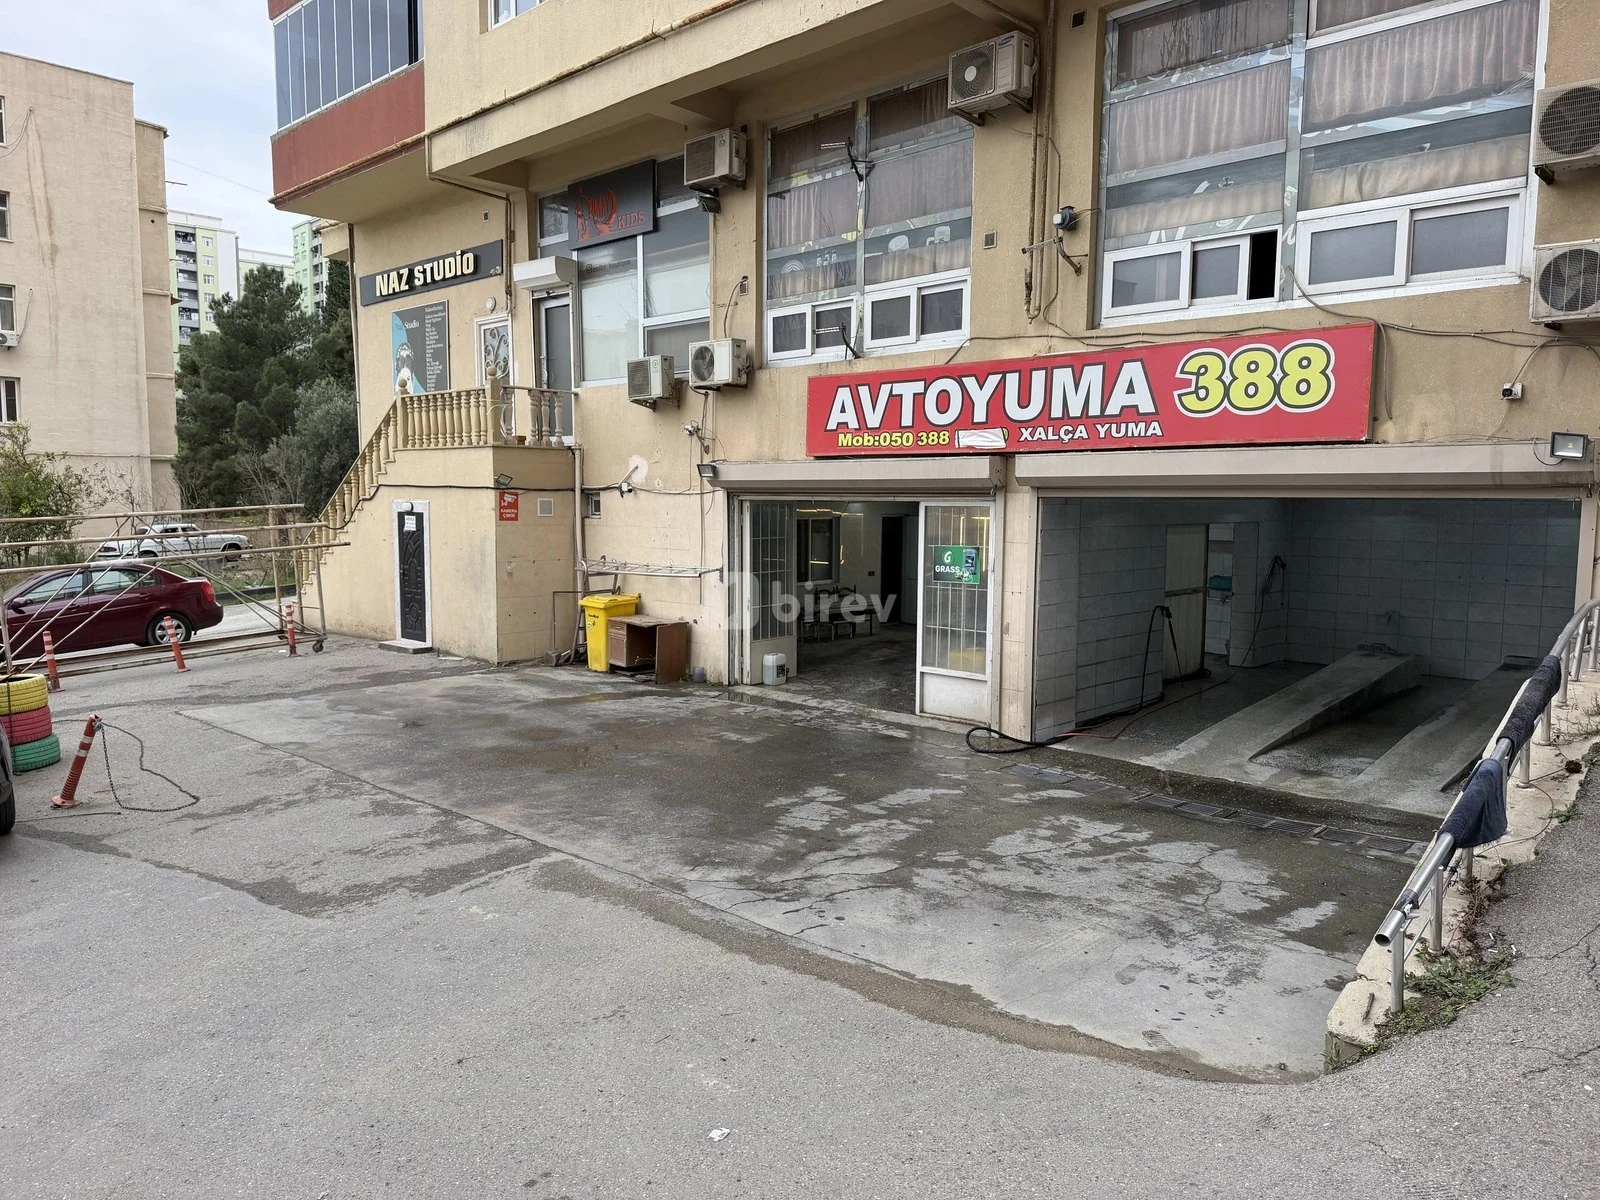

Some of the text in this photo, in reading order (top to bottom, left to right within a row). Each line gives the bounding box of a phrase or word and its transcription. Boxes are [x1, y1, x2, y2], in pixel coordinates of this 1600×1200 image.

[617, 211, 646, 229] KIDS
[375, 268, 409, 297] NAZ
[1176, 340, 1333, 415] 388
[825, 358, 1158, 431] AVTOYUMA
[837, 431, 914, 447] Mob:050
[917, 430, 950, 446] 388
[1019, 426, 1089, 443] XALÇA
[1095, 421, 1163, 438] YUMA
[935, 565, 960, 573] GRASS
